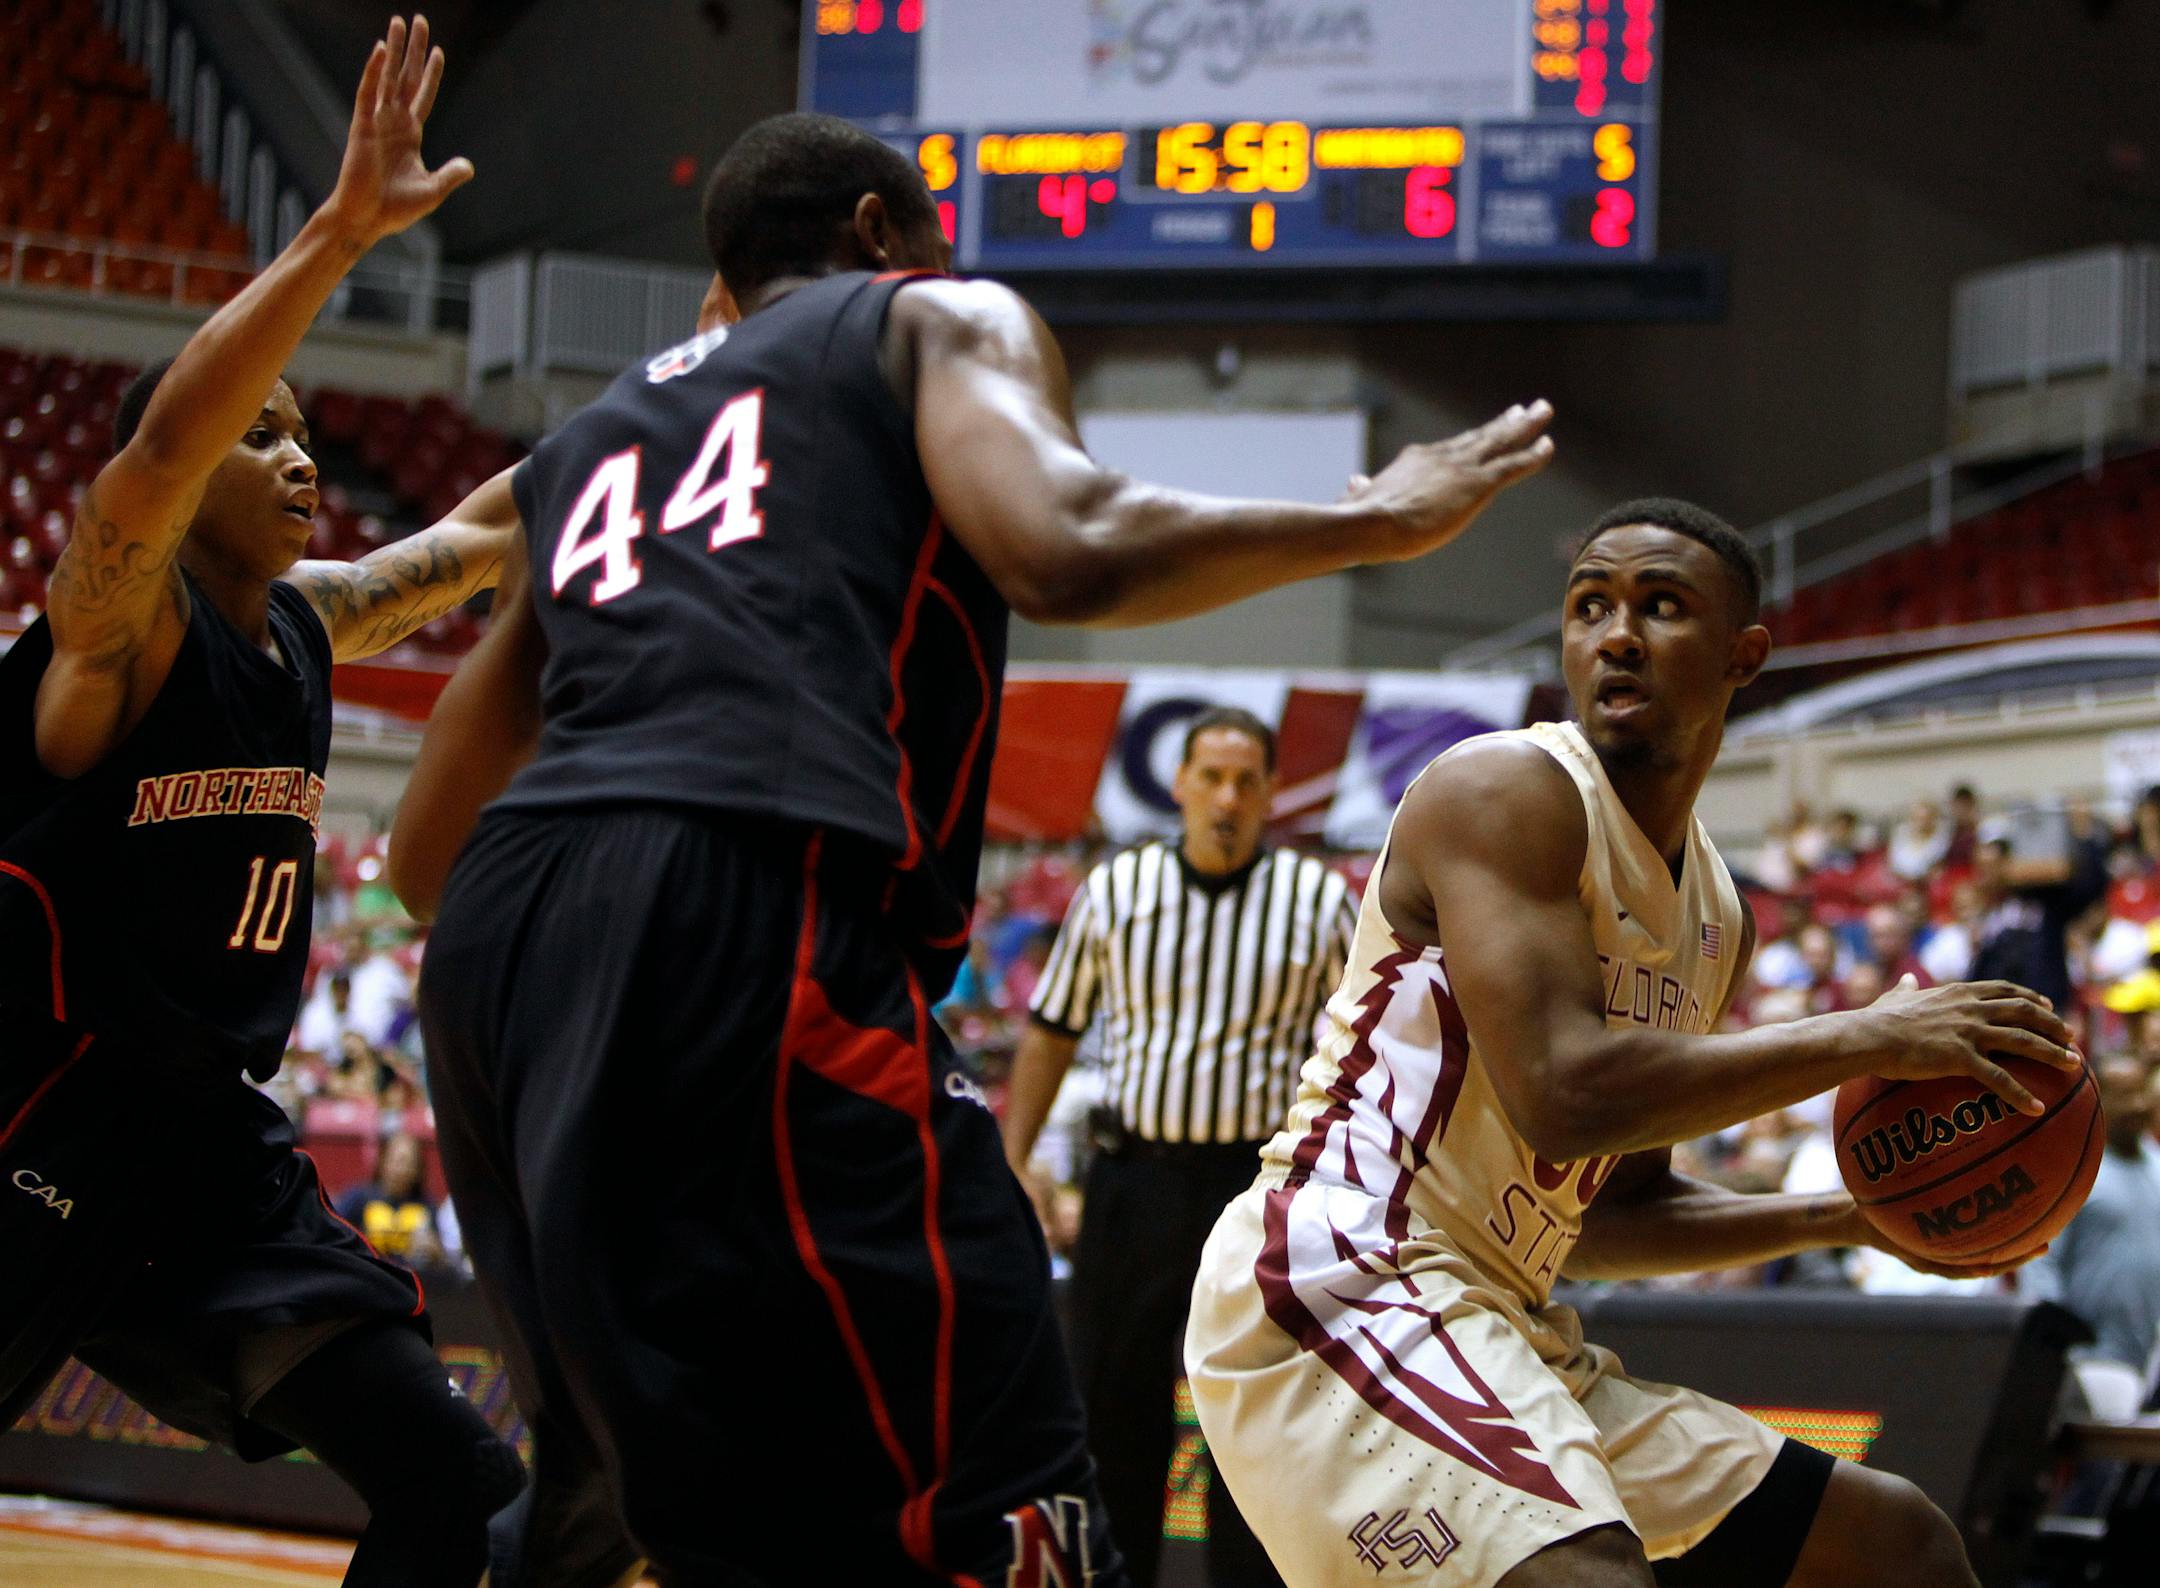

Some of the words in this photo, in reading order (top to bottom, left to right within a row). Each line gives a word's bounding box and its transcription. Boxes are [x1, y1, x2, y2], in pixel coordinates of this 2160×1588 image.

[1155, 122, 1310, 193] 15:58
[1594, 124, 1636, 182] 5
[1038, 175, 1087, 238] 4
[1250, 202, 1276, 251] 1
[1404, 166, 1456, 238] 6
[1590, 187, 1635, 248] 2
[551, 385, 771, 606] 44
[227, 856, 298, 954] 10
[1850, 1090, 2020, 1184] Wilson
[12, 1169, 74, 1219] CAA
[1911, 1163, 2037, 1240] NCAA
[1348, 1506, 1462, 1576] FSU
